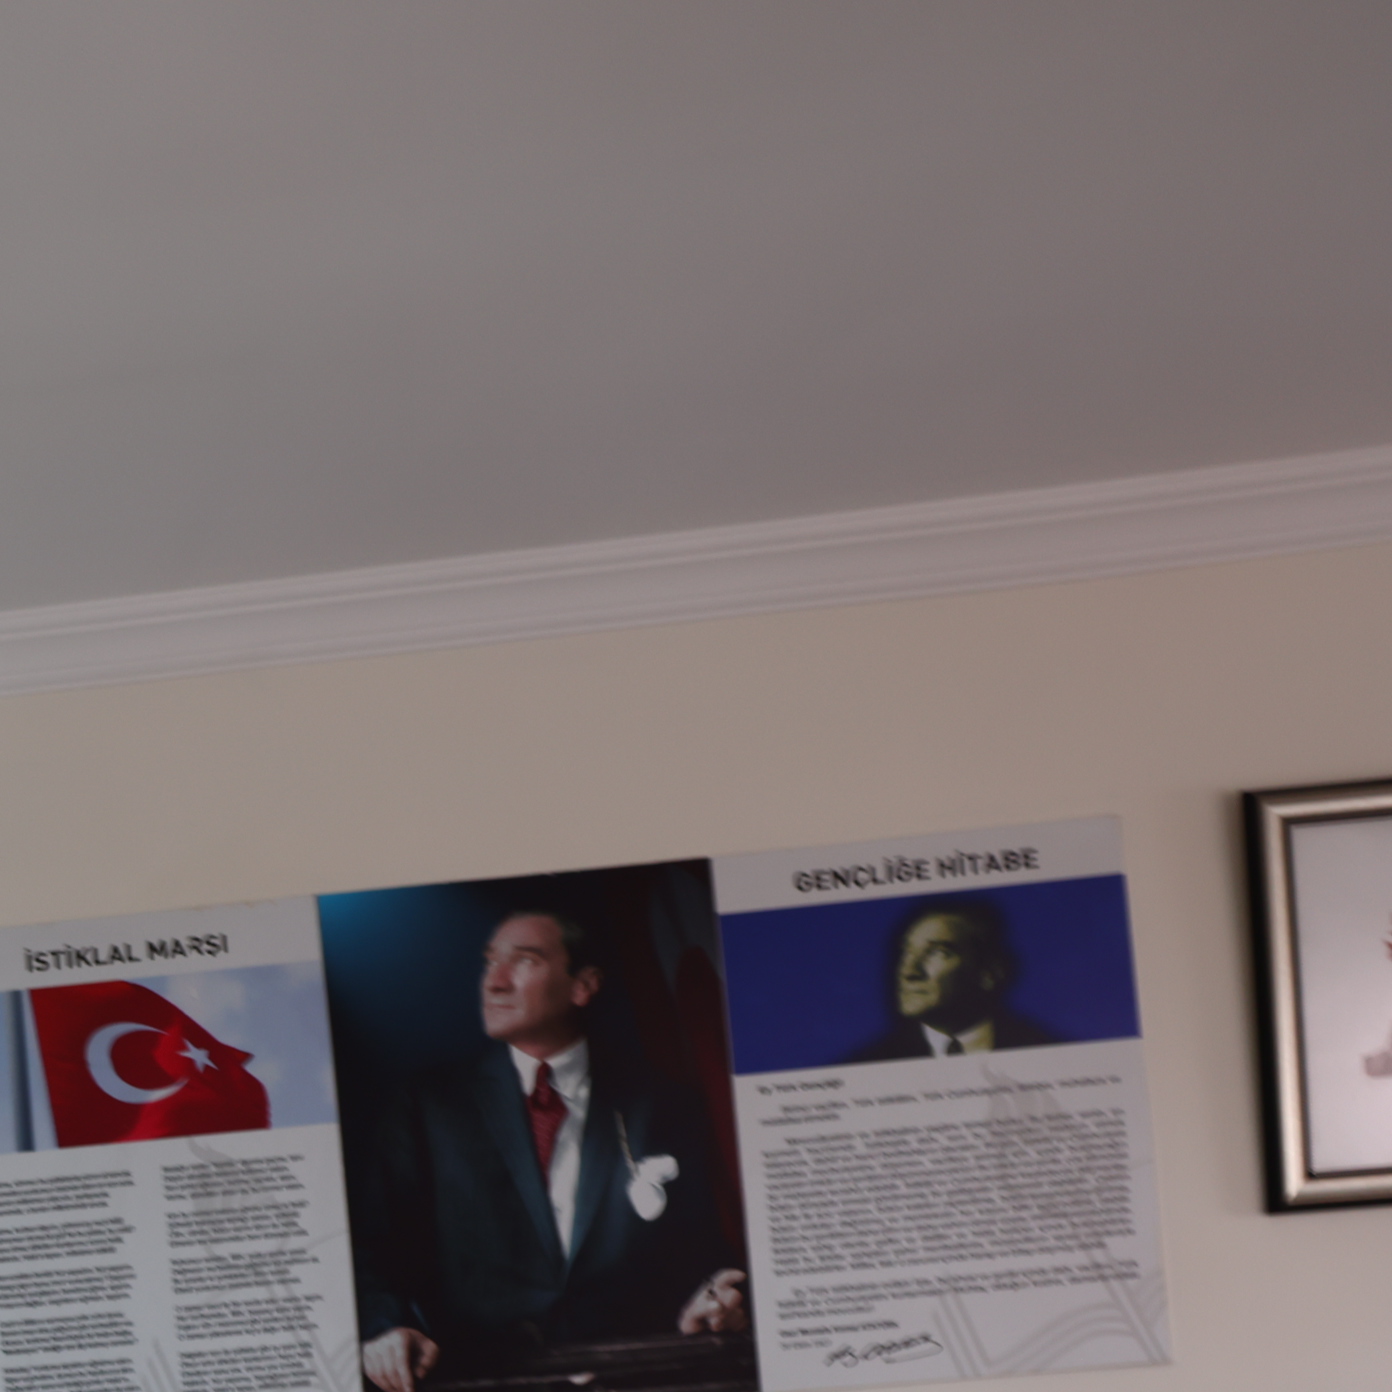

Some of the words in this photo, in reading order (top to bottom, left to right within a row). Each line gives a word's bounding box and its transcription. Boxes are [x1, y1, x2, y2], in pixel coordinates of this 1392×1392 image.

[793, 856, 931, 893] GENÇLİĞE
[935, 847, 1039, 879] HİTABE
[24, 943, 142, 973] İSTİKLAL
[145, 933, 229, 961] MARŞI
